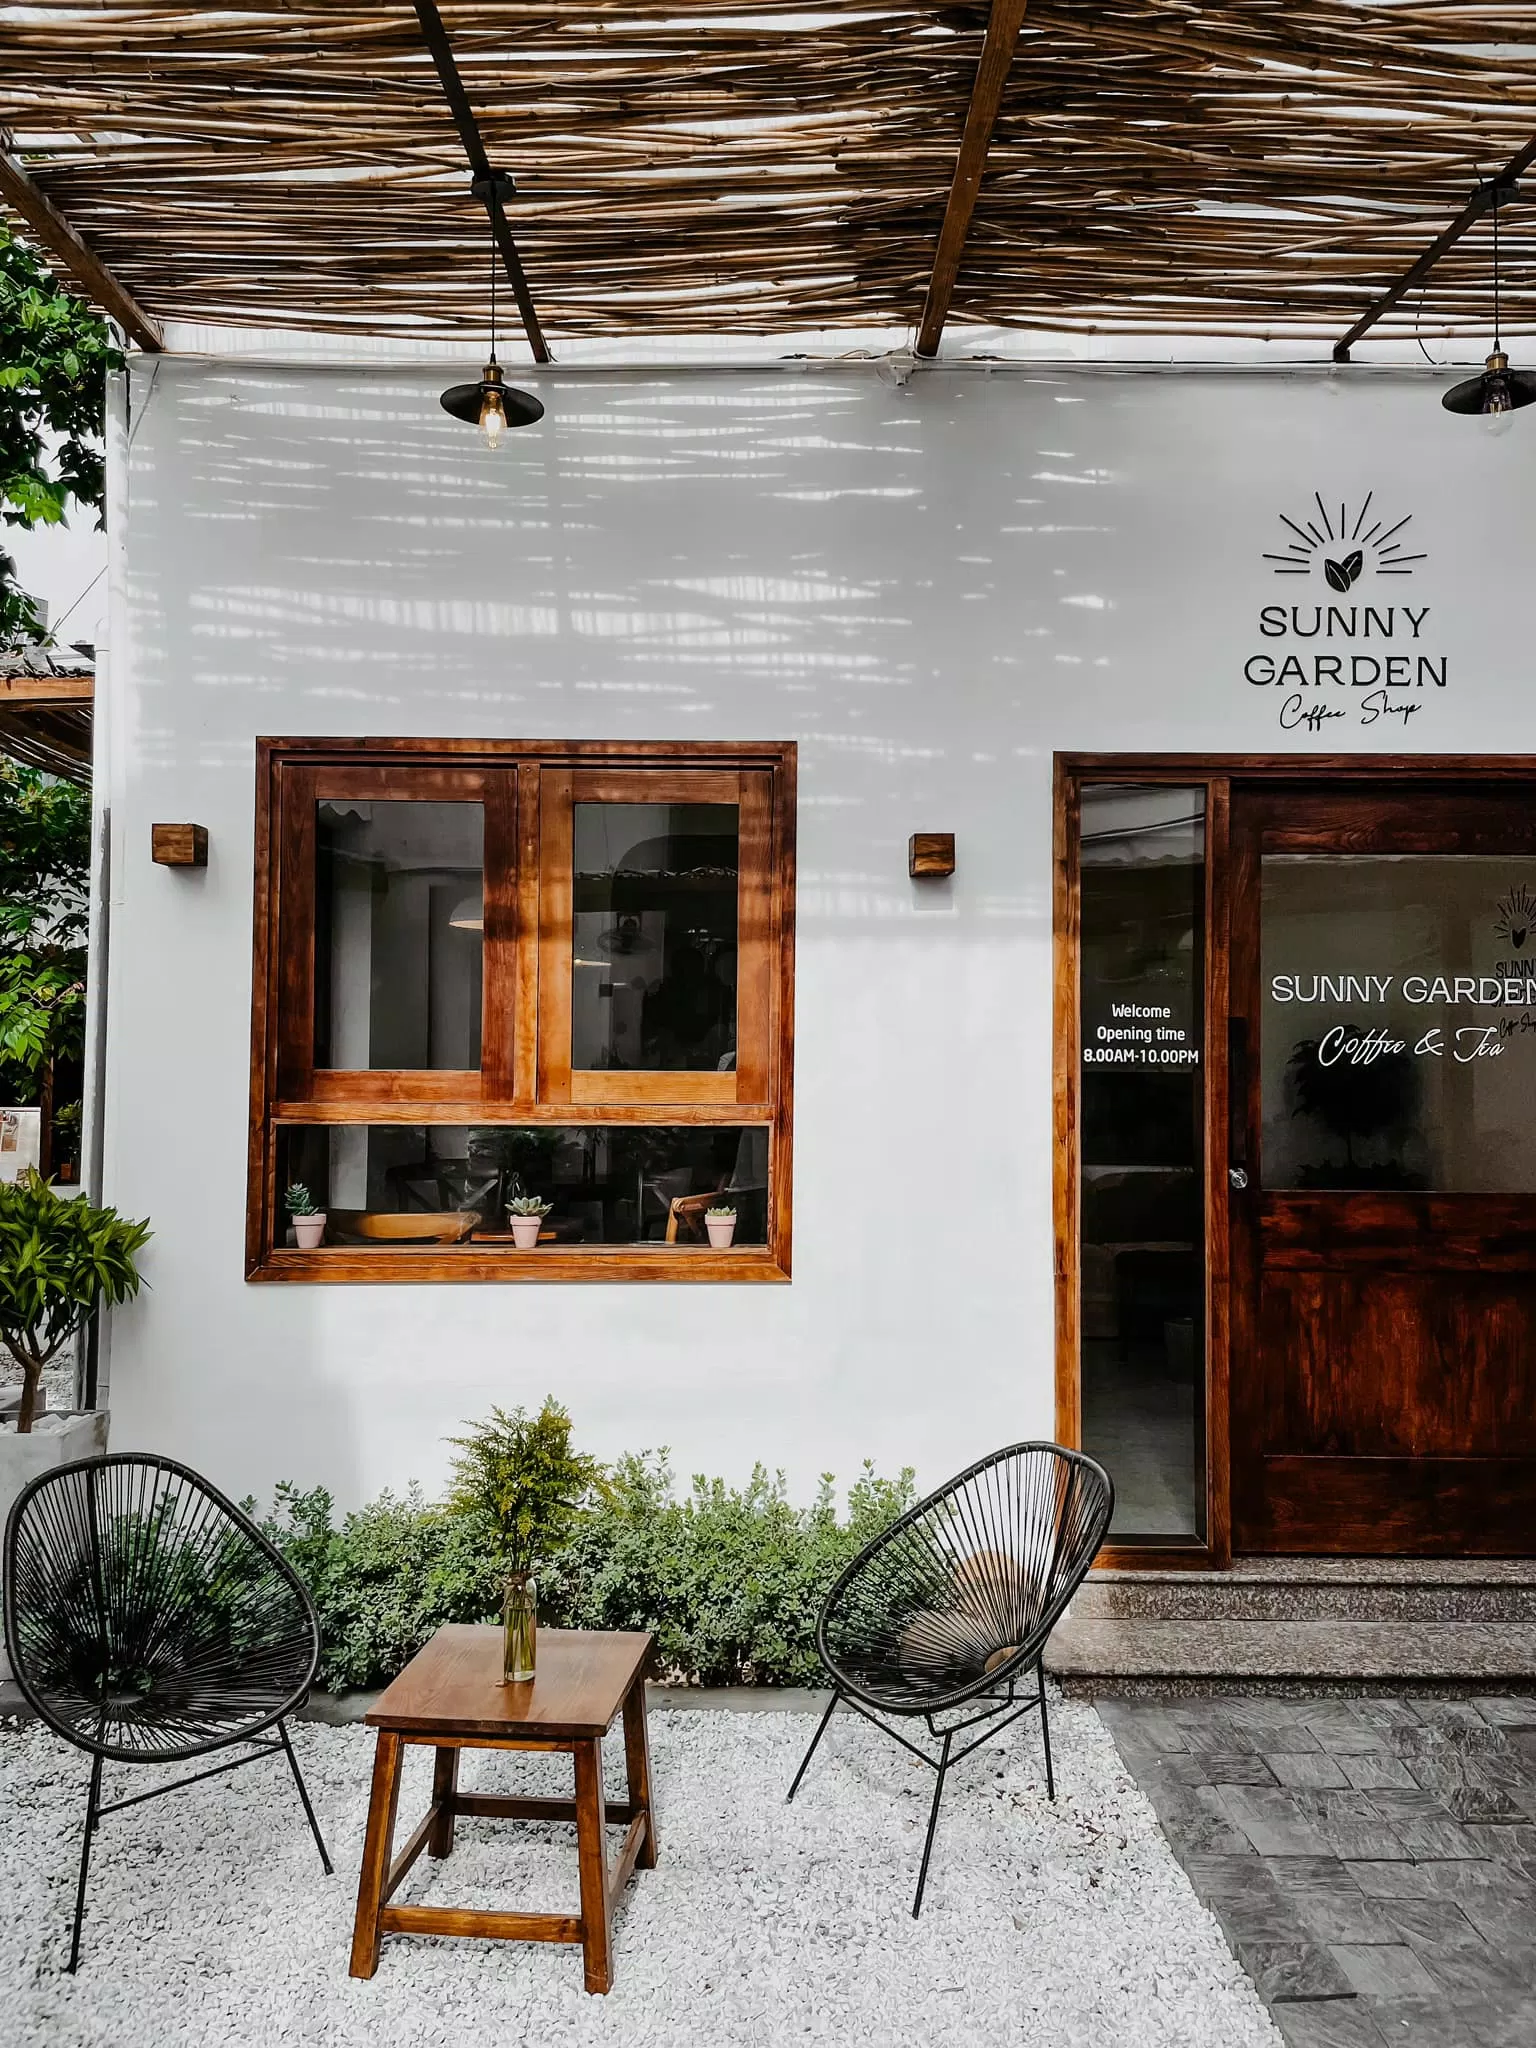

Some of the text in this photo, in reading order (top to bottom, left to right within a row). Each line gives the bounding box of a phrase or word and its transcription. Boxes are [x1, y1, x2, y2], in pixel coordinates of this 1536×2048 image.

[1260, 606, 1431, 638] SUNNY
[1244, 655, 1448, 687] GARDEN
[1280, 690, 1422, 732] Coffee Shop
[1495, 959, 1536, 978] SUNN
[1271, 975, 1393, 1003] SUNNY
[1112, 1003, 1171, 1018] Welcome
[1097, 1026, 1186, 1043] Opening time
[1318, 1025, 1505, 1067] Coffee & Tea
[1083, 1048, 1199, 1064] 8.00AM-10.00PM
